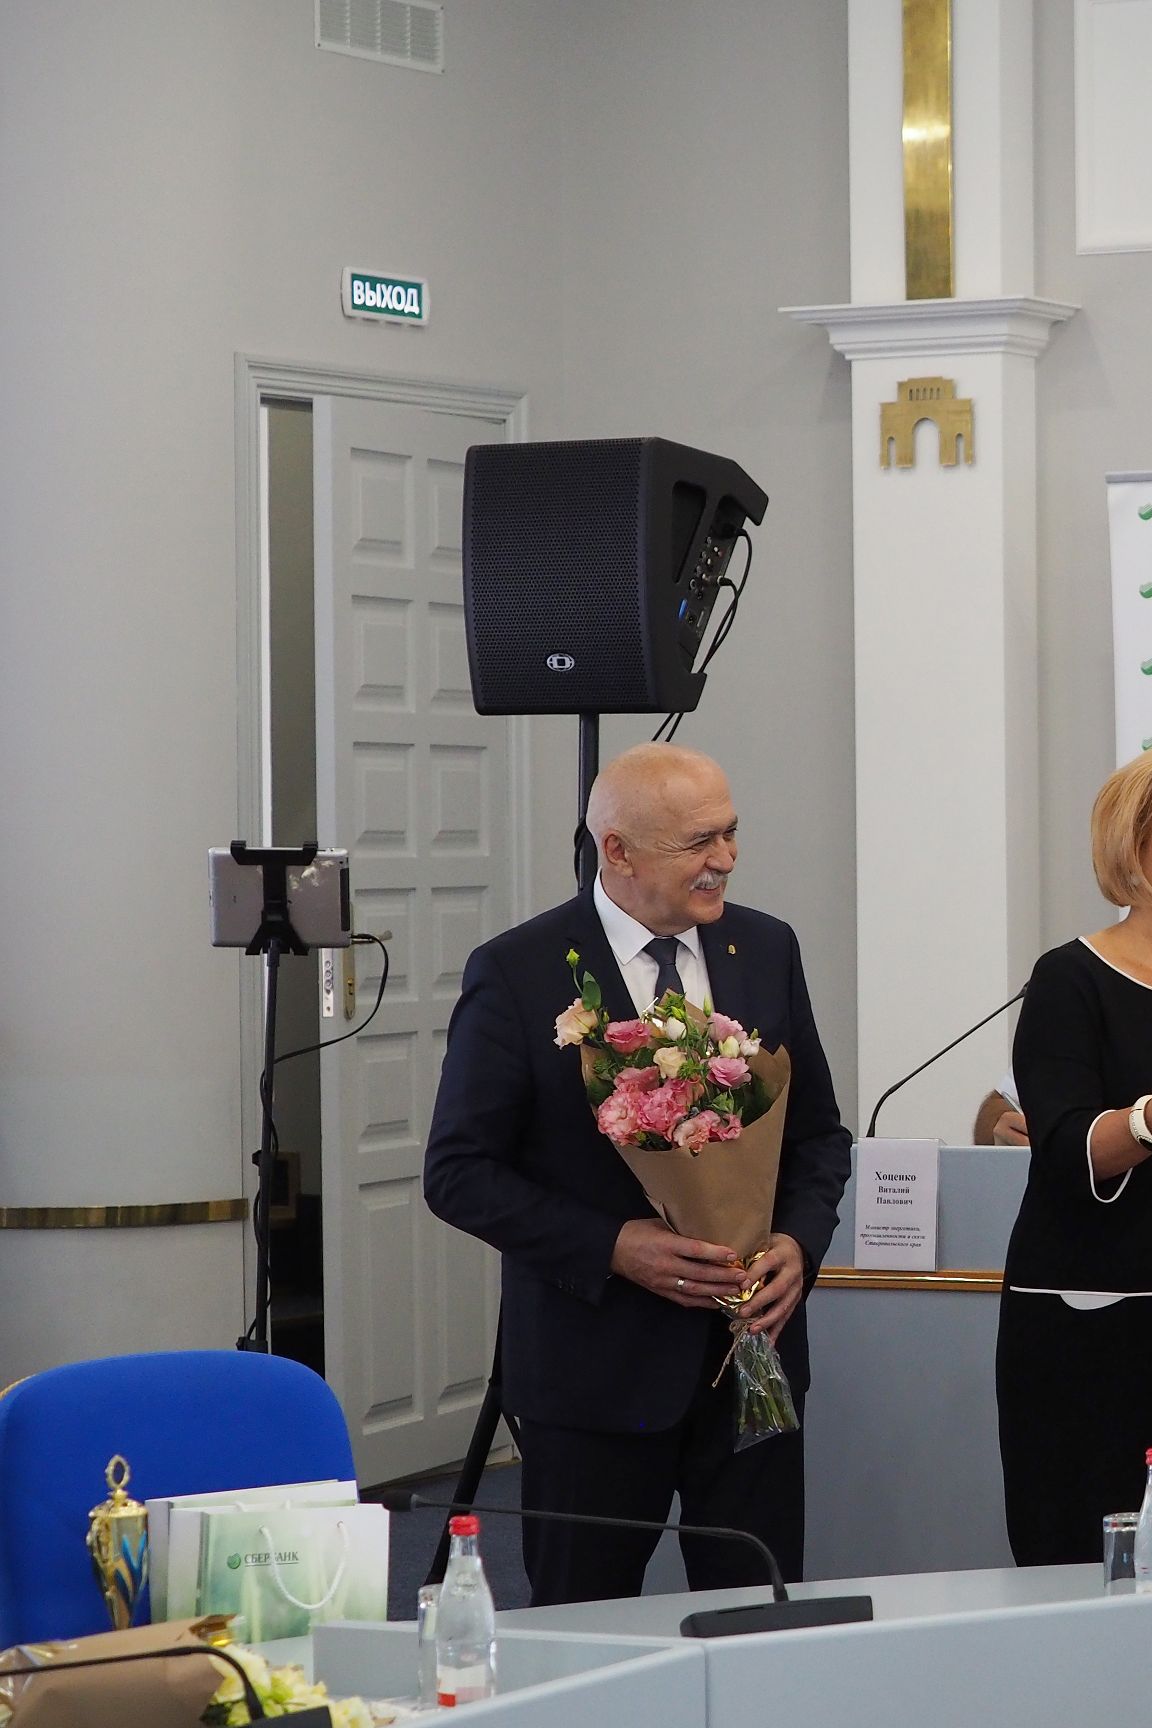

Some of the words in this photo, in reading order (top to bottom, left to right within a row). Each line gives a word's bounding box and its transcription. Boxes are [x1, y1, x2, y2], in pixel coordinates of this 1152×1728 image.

[353, 280, 420, 315] ВЫХОД
[875, 1171, 917, 1182] Хоценко
[244, 1551, 299, 1563] СБЕРАНК
